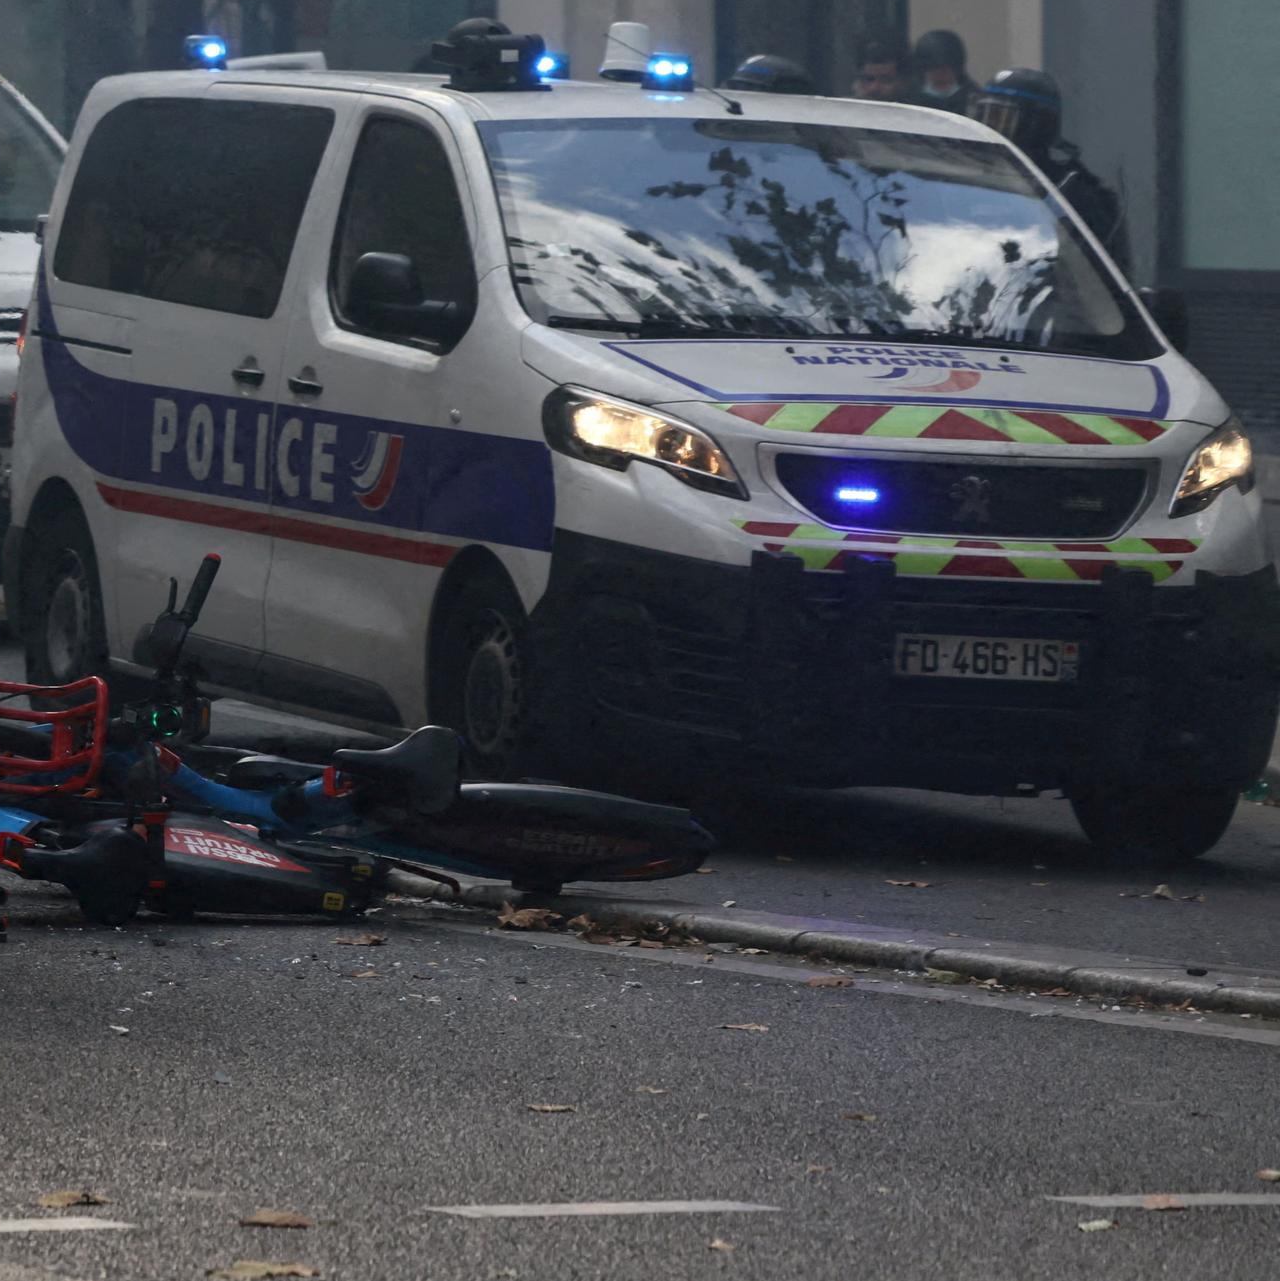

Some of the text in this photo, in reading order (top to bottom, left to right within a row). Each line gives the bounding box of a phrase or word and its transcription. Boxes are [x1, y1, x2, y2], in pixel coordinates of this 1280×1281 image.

[793, 355, 1026, 373] NATIONALE
[826, 347, 967, 359] POLICE
[151, 397, 337, 503] POLICE
[900, 638, 1059, 678] FD-466-HS
[184, 836, 281, 862] GRATUIT
